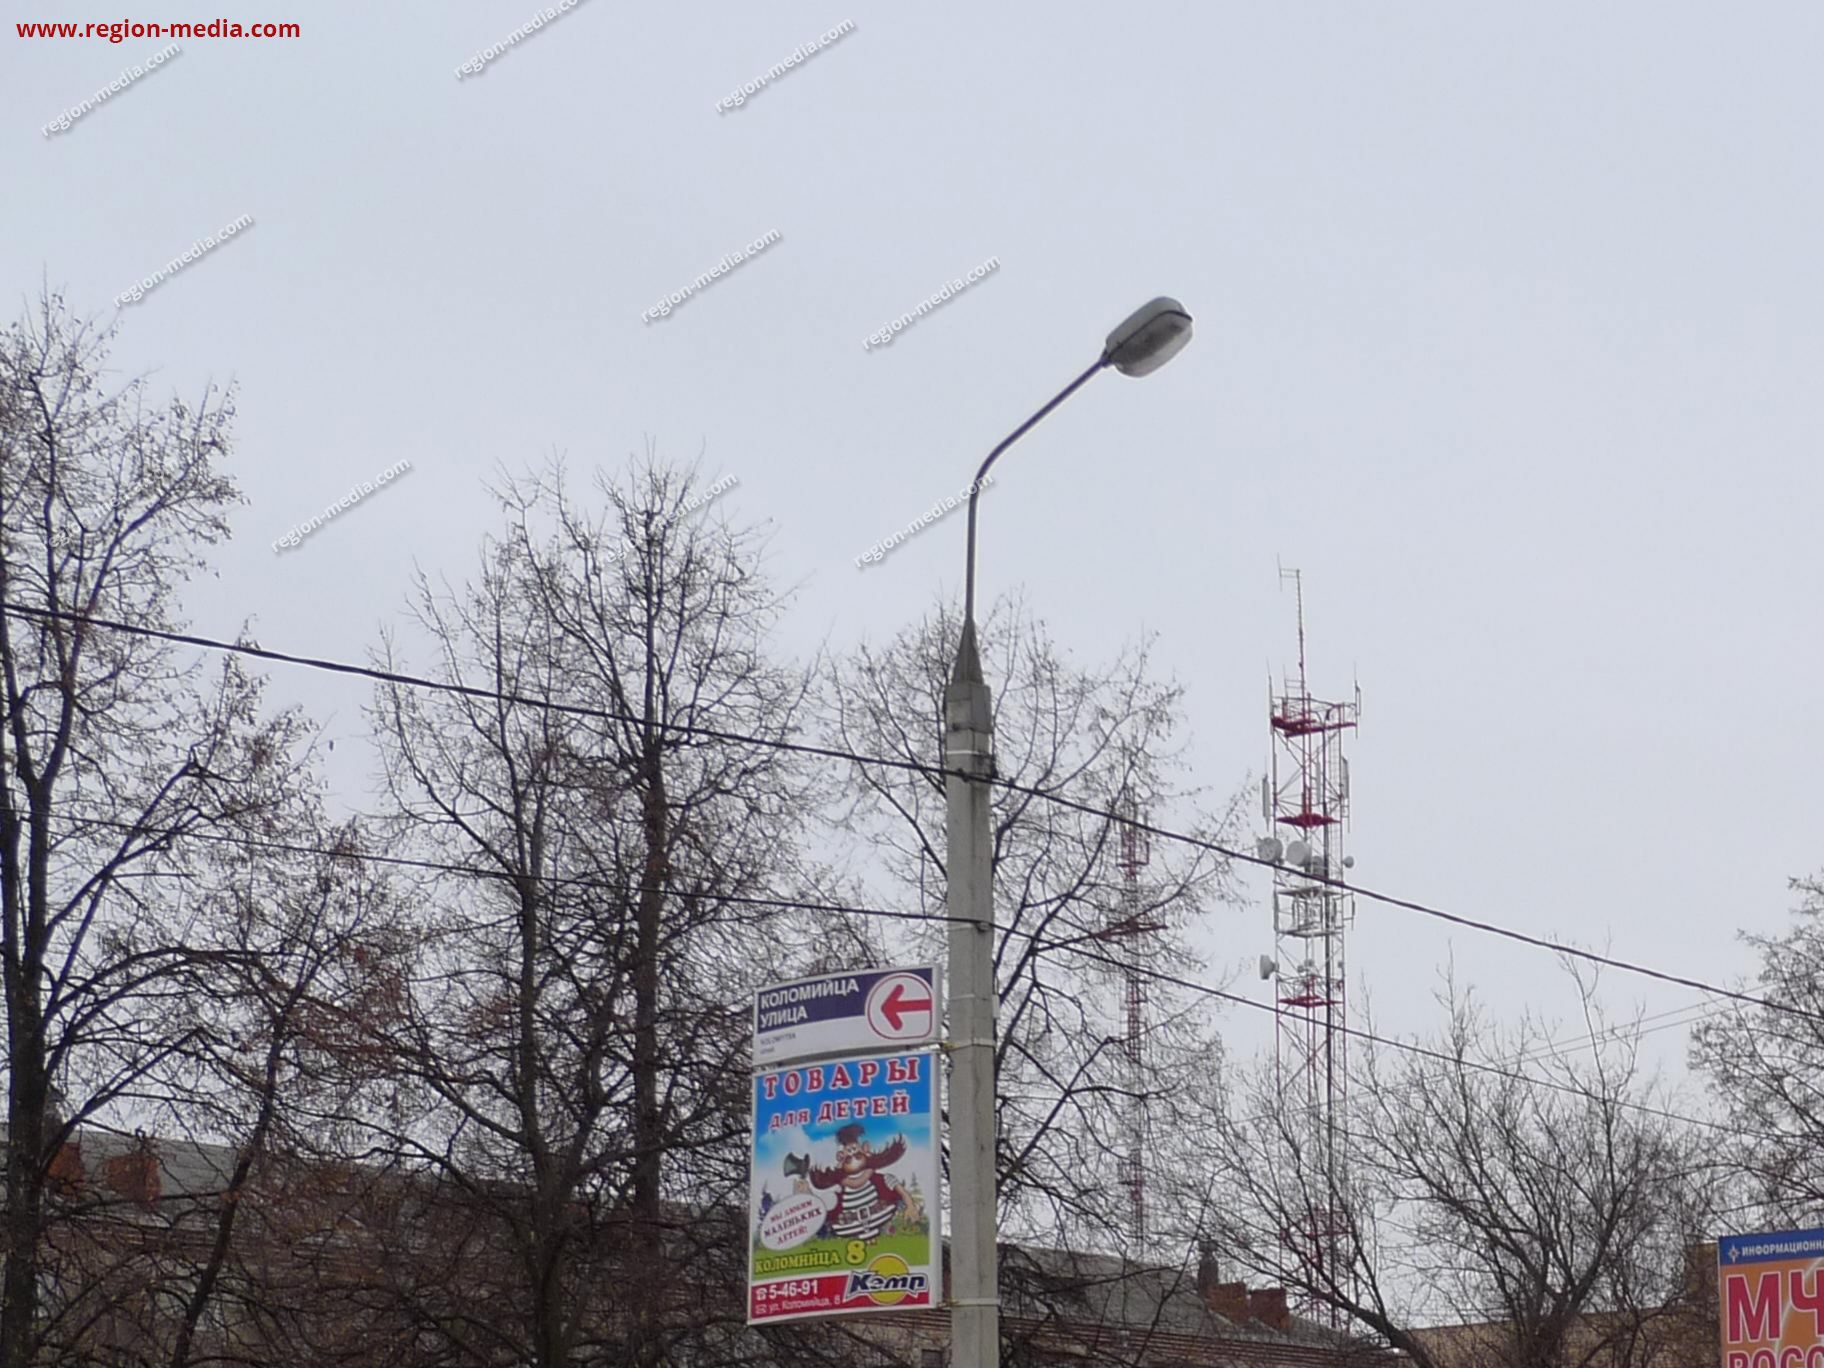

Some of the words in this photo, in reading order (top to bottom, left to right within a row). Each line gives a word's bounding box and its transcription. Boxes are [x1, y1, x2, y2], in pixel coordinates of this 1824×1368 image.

[760, 977, 860, 1009] КОЛОМИЙЦА
[760, 1006, 808, 1028] УЛИЦА
[764, 1058, 920, 1098] ТОВАРЫ
[817, 1091, 910, 1123] ДЕТЕЙ
[754, 1248, 841, 1273] КОЛОМИЙЦА
[846, 1240, 866, 1264] 8
[769, 1280, 819, 1301] 5-46-91
